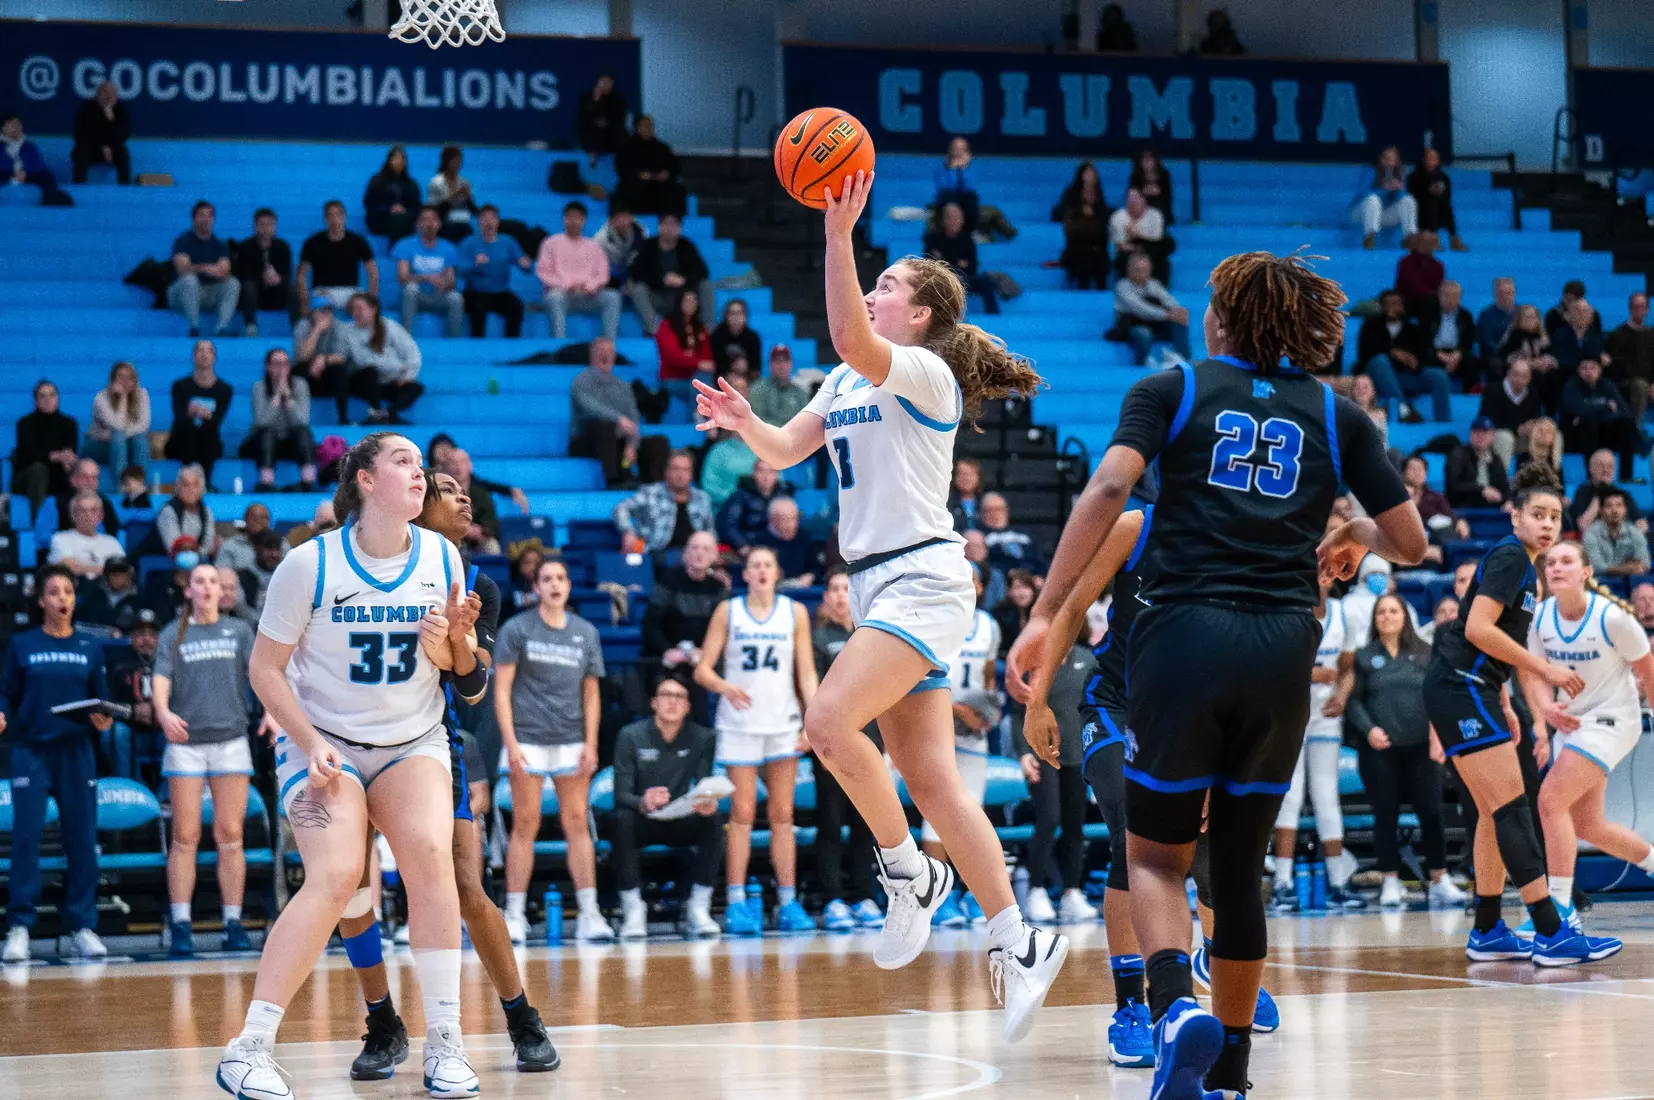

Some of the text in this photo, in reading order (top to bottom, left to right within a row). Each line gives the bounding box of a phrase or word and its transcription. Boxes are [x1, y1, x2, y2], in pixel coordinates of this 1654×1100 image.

[878, 69, 1368, 143] COLUMBIA
[1208, 409, 1304, 499] 23
[331, 605, 436, 623] COLUMBI
[348, 631, 420, 686] 33
[741, 645, 779, 672] 34
[961, 662, 971, 688] 1
